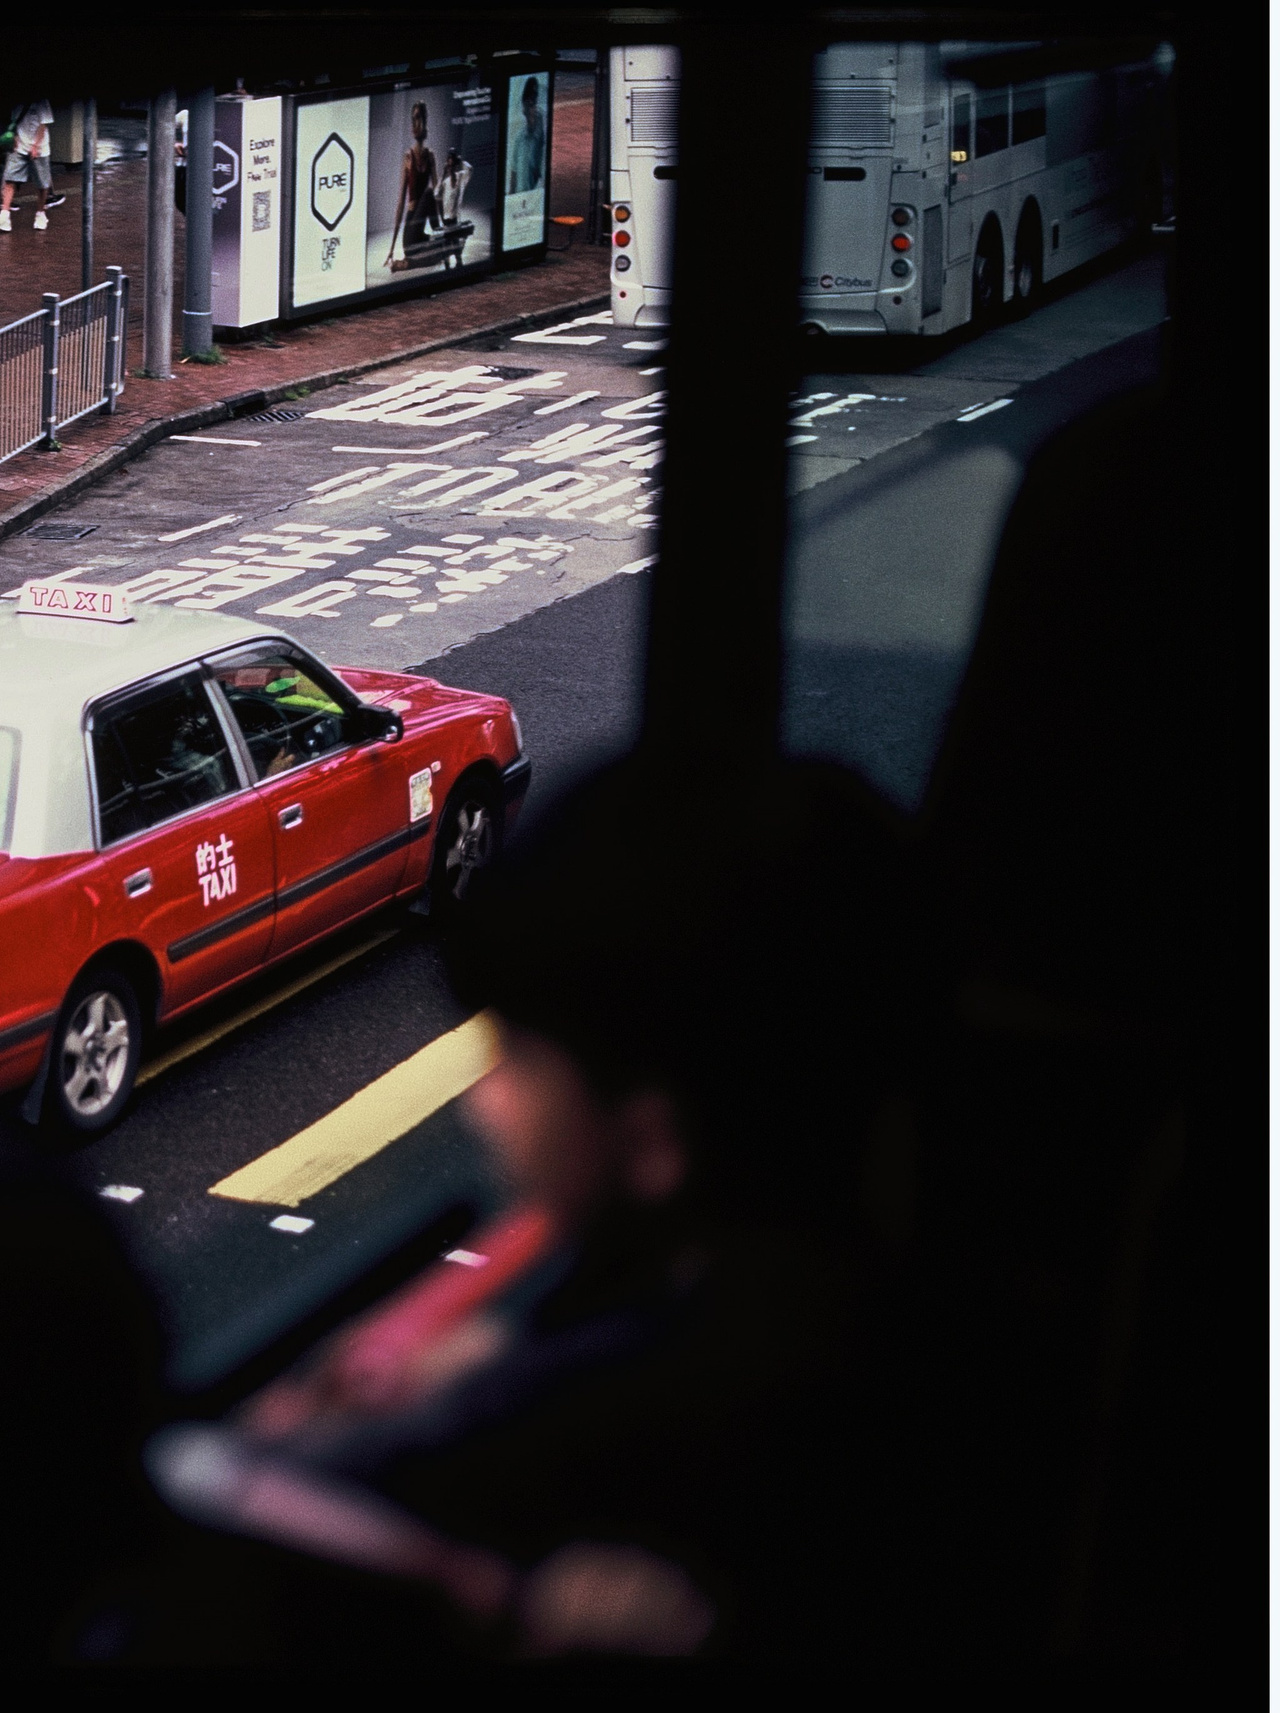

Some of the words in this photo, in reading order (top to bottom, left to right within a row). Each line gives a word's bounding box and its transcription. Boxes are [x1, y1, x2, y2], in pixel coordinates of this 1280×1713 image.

[319, 172, 347, 191] PURE
[30, 586, 112, 614] TAXI
[195, 833, 235, 876] 的士
[199, 863, 237, 907] TAXI
